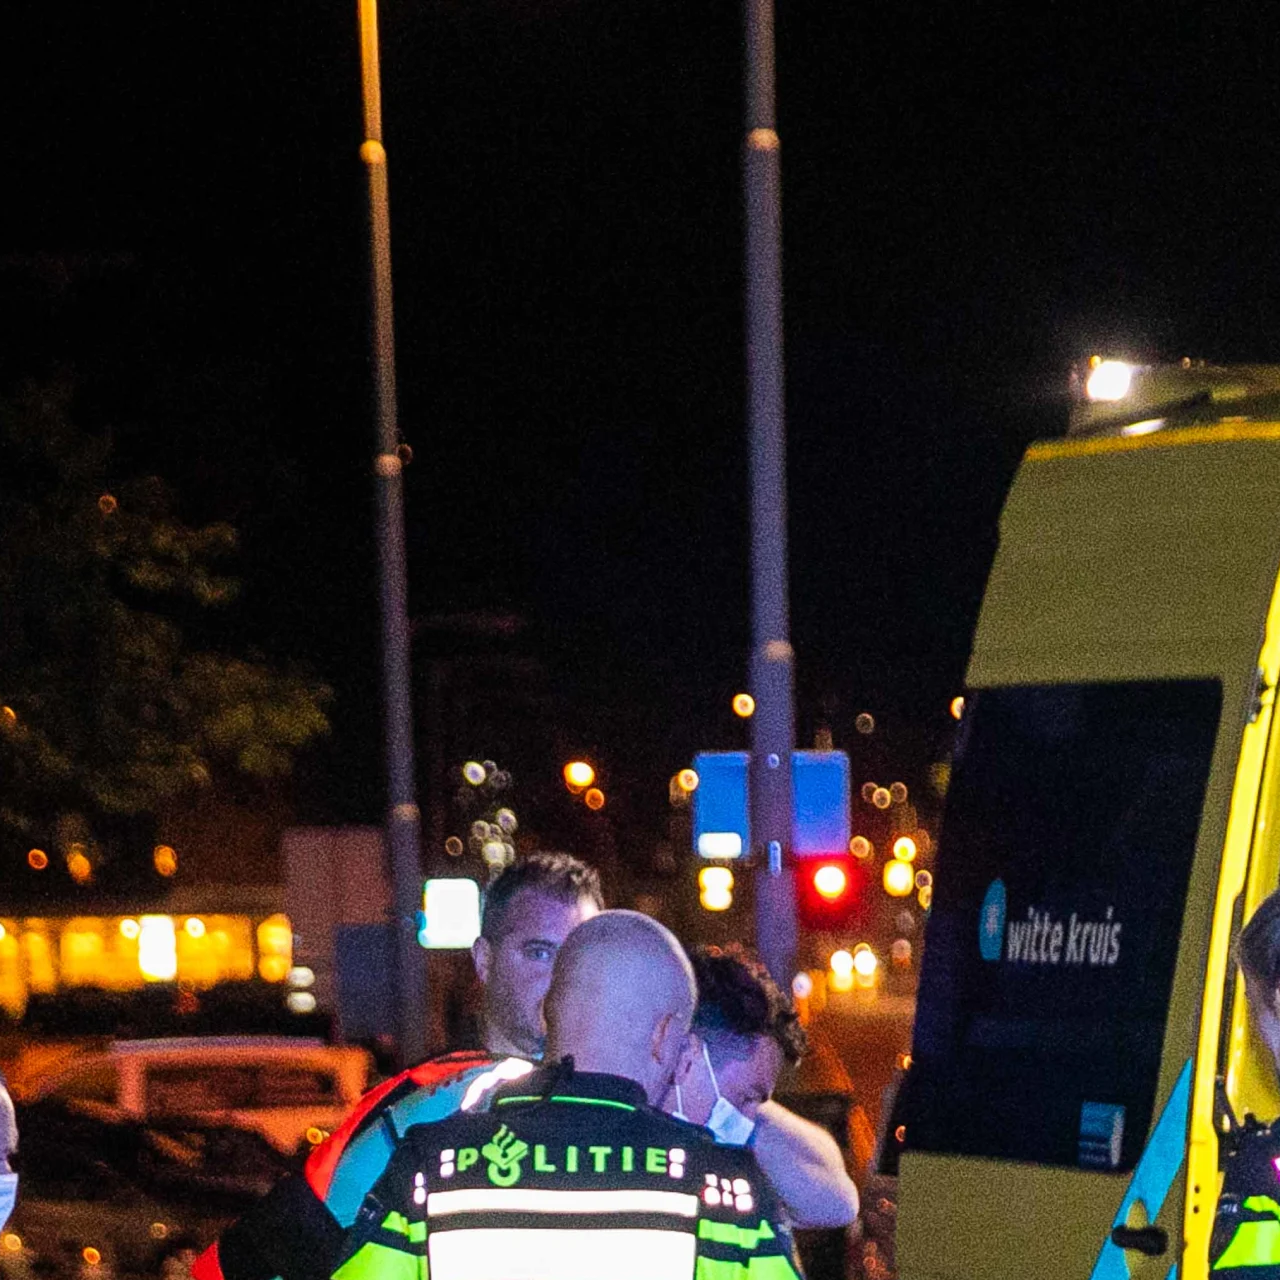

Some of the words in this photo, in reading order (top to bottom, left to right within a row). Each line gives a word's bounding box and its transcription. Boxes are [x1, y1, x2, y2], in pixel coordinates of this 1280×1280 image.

[1007, 896, 1063, 965] witte
[1065, 895, 1122, 966] kruis
[457, 1130, 669, 1187] POLITIE
